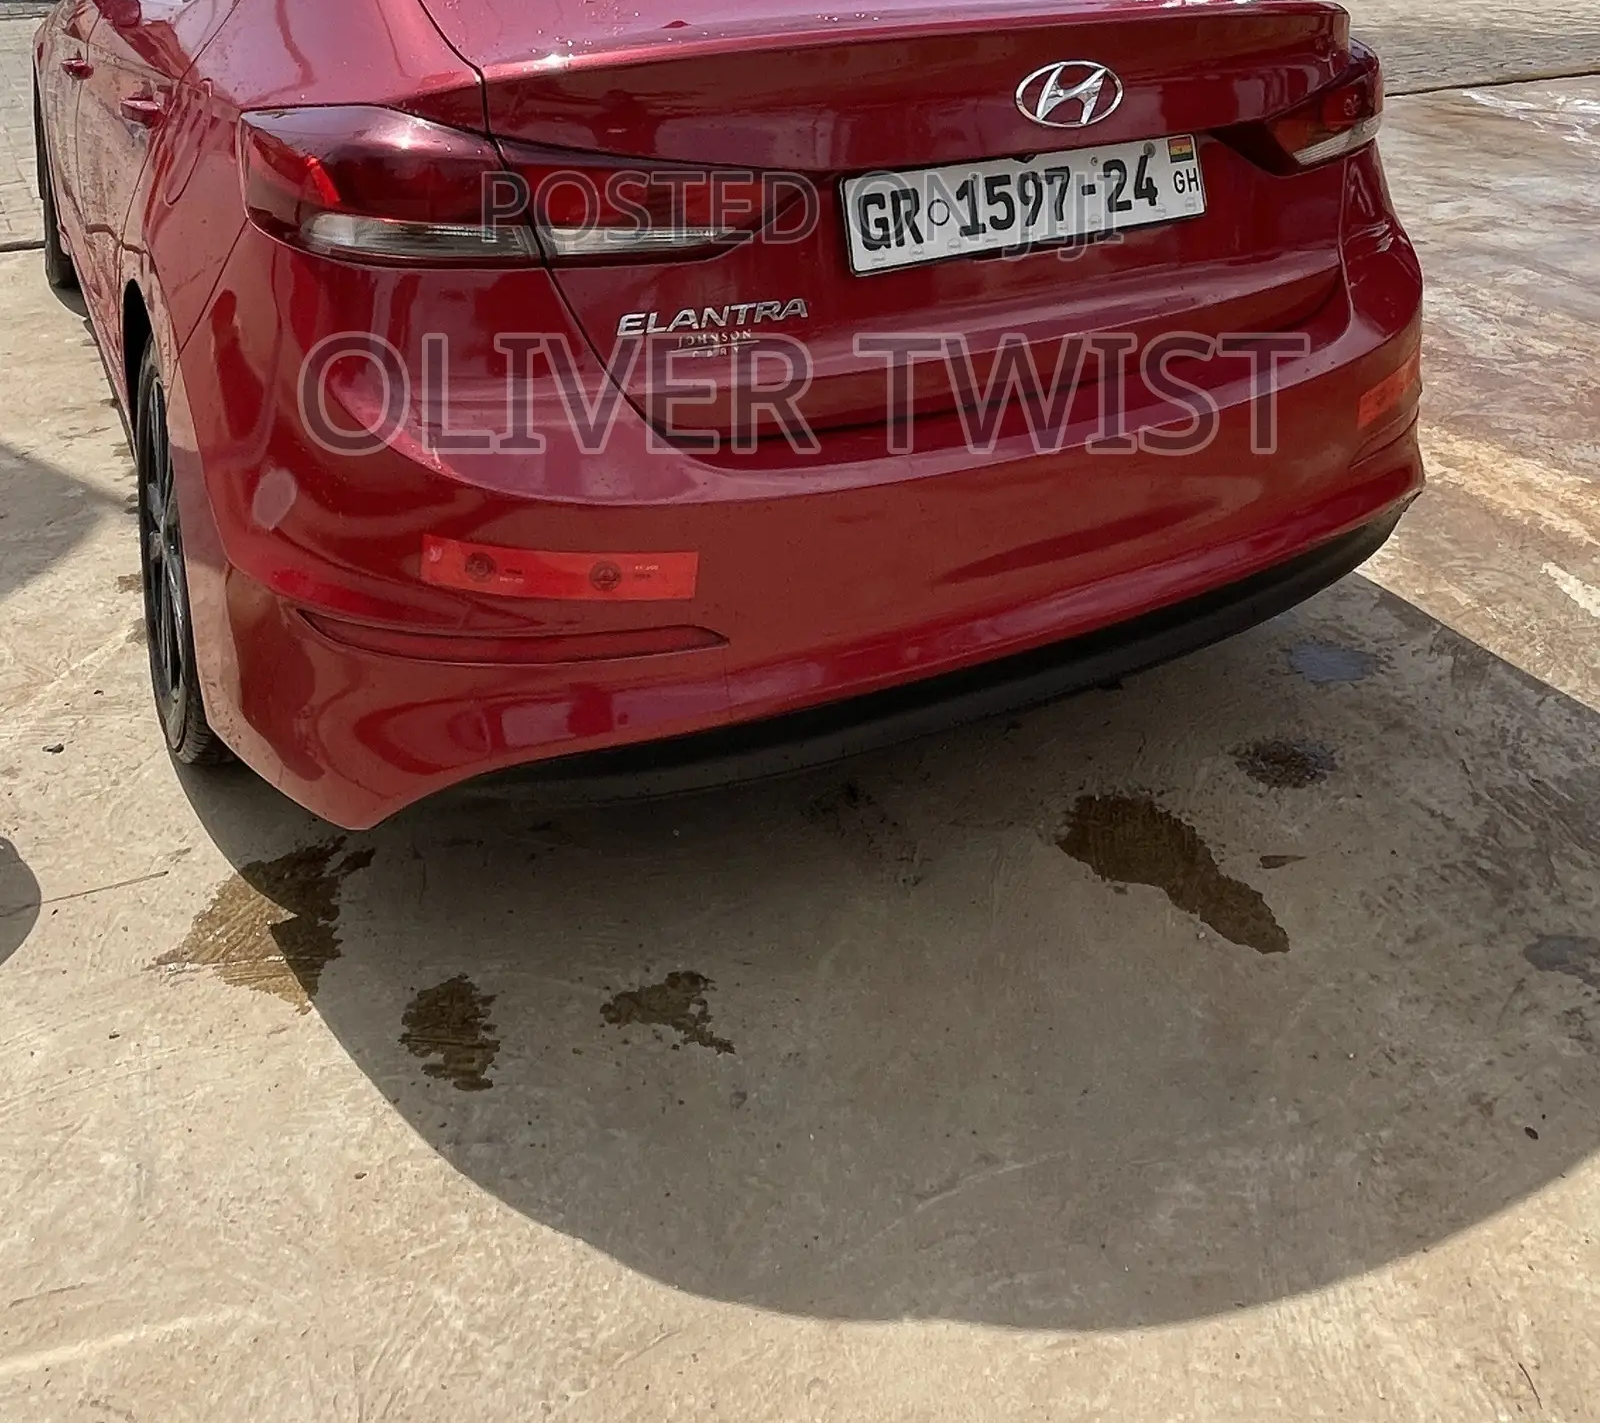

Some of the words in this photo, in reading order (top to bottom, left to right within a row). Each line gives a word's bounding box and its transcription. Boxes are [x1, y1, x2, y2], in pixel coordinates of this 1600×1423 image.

[1173, 167, 1200, 195] GH
[857, 187, 925, 251] GR
[616, 298, 809, 336] ELANTRA
[678, 328, 752, 349] JOHNSON
